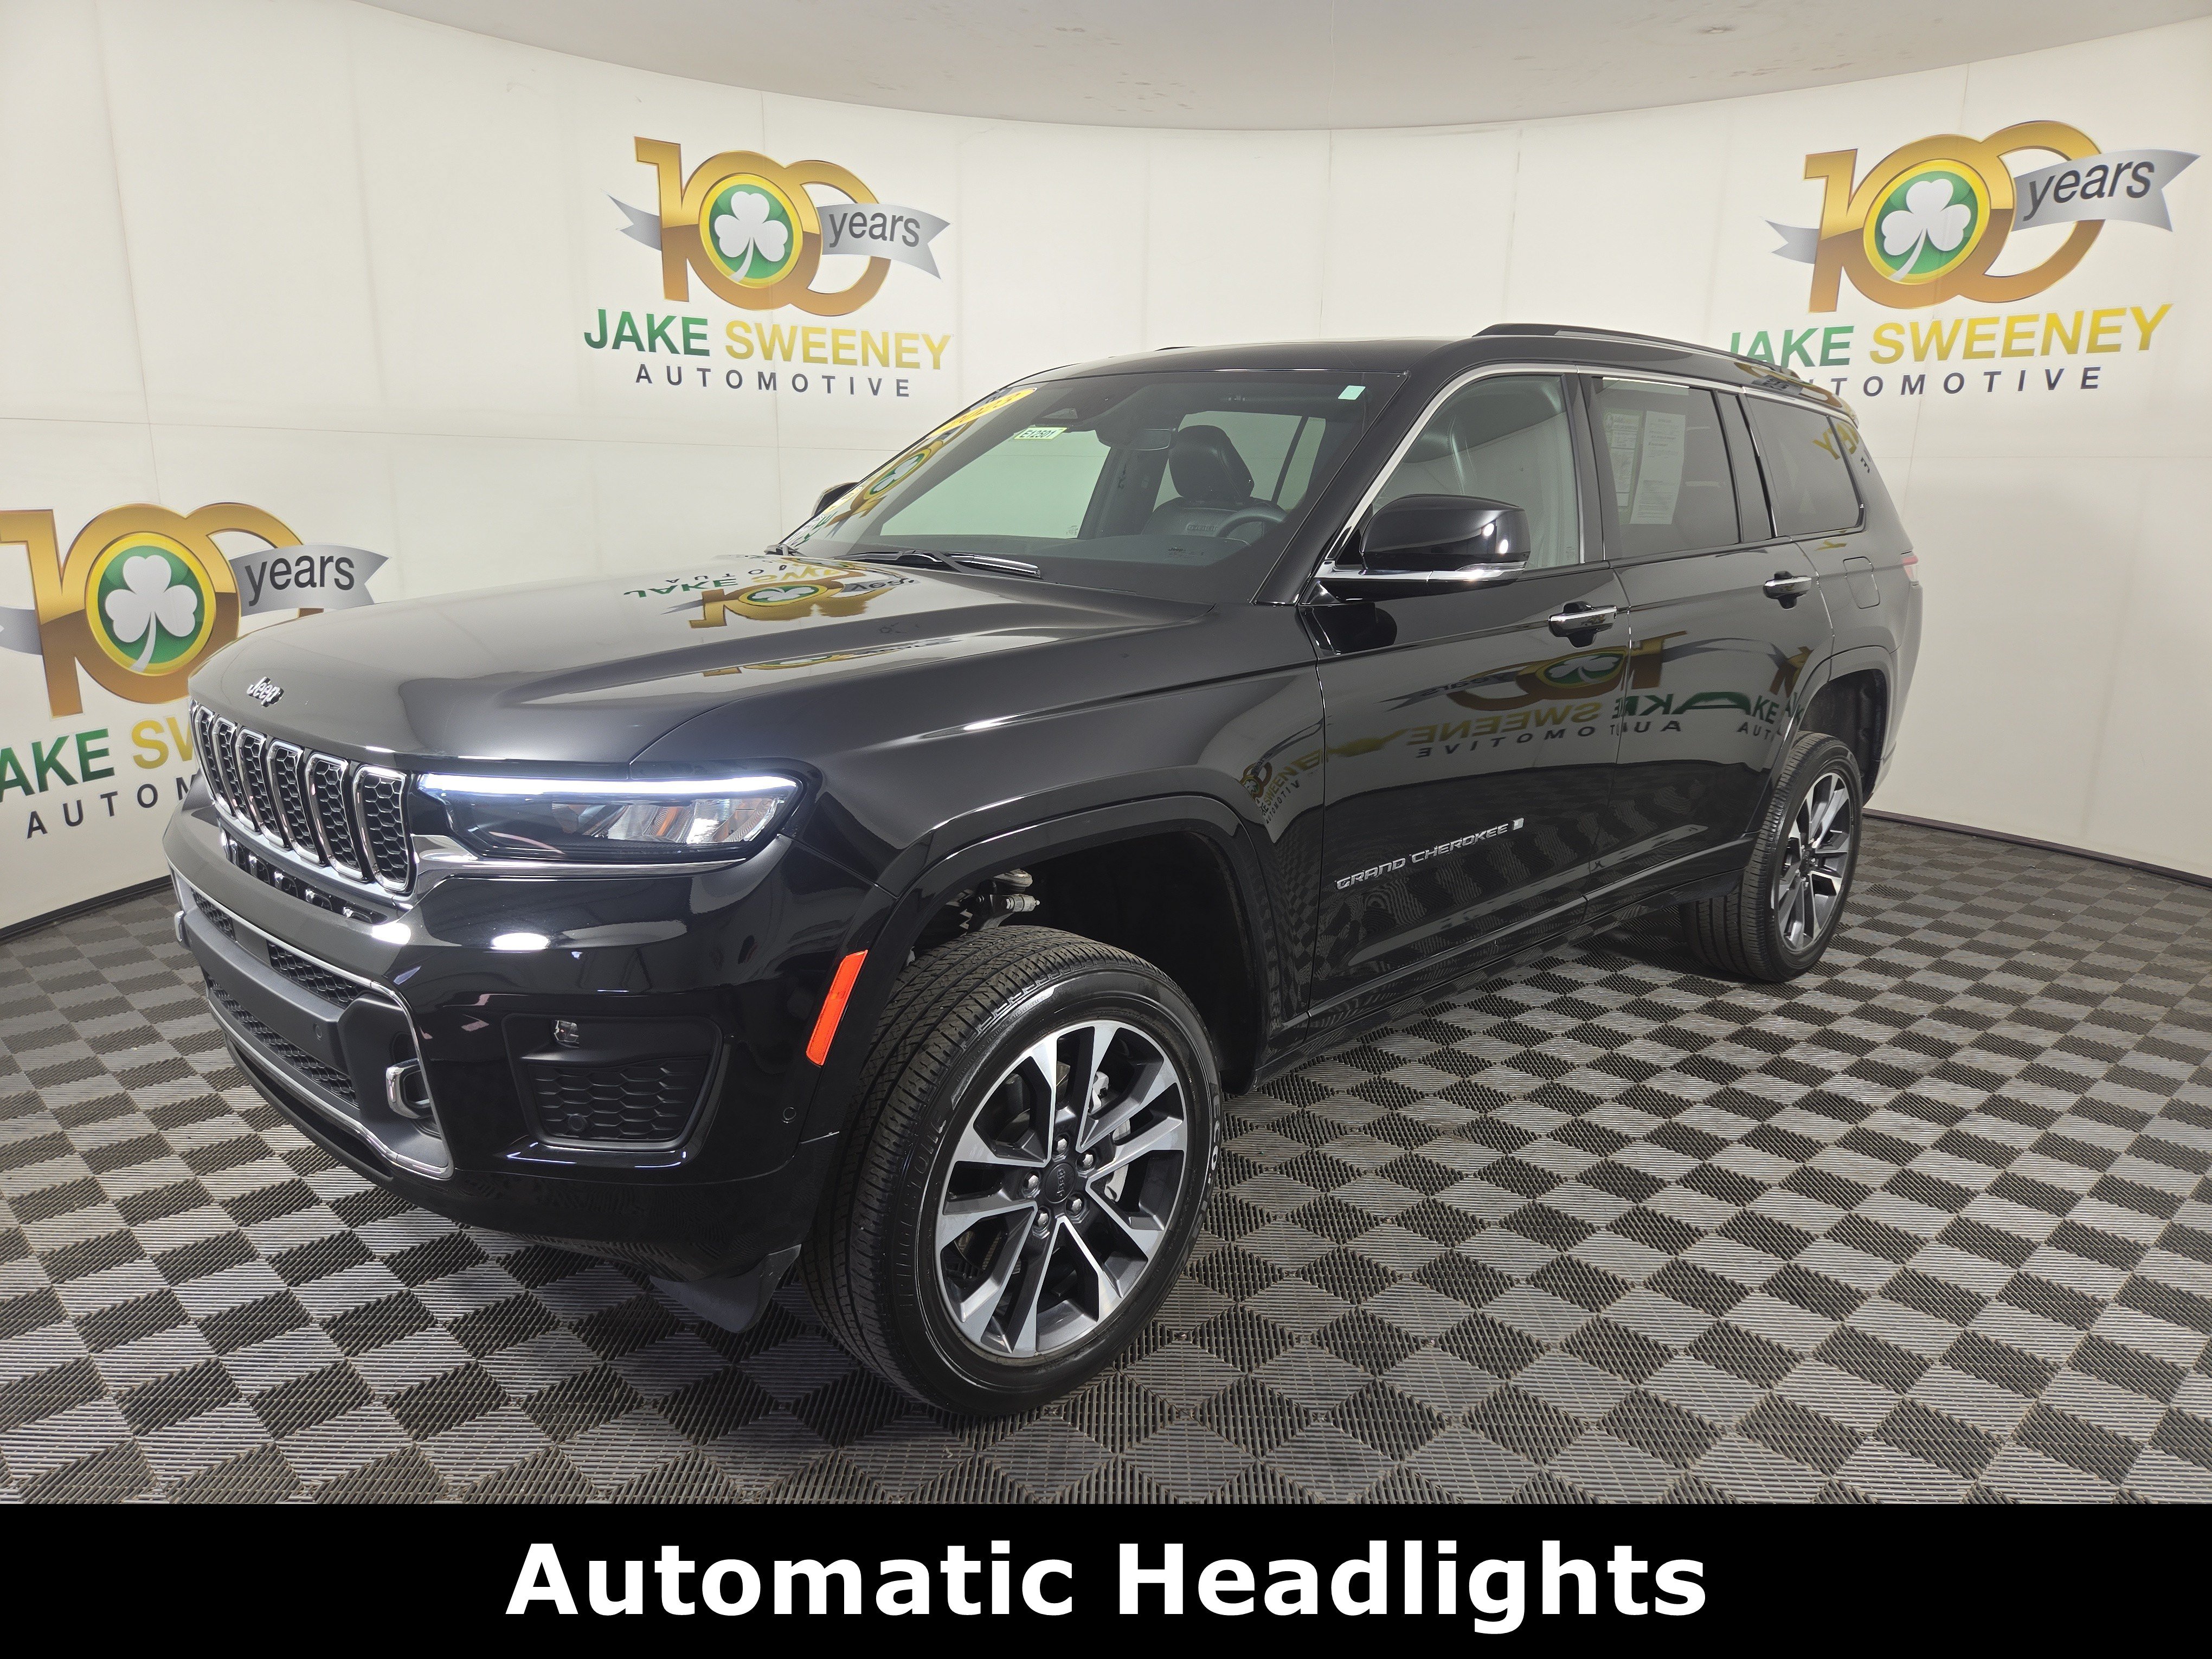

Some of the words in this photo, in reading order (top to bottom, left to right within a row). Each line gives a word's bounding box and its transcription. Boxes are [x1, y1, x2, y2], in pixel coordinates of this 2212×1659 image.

[2023, 159, 2155, 222] years
[828, 210, 921, 248] years
[584, 308, 710, 357] JAKE
[725, 320, 953, 370] SWEENEY
[1869, 303, 2174, 365] SWEENEY
[635, 363, 910, 397] AUTOMOTIVE
[1809, 366, 2101, 397] TOMOTIVE
[245, 555, 355, 607] years
[246, 676, 283, 707] Jeep
[0, 728, 115, 803] AKE
[1336, 857, 1406, 890] GRAND
[1411, 823, 1509, 864] CHEROKEE
